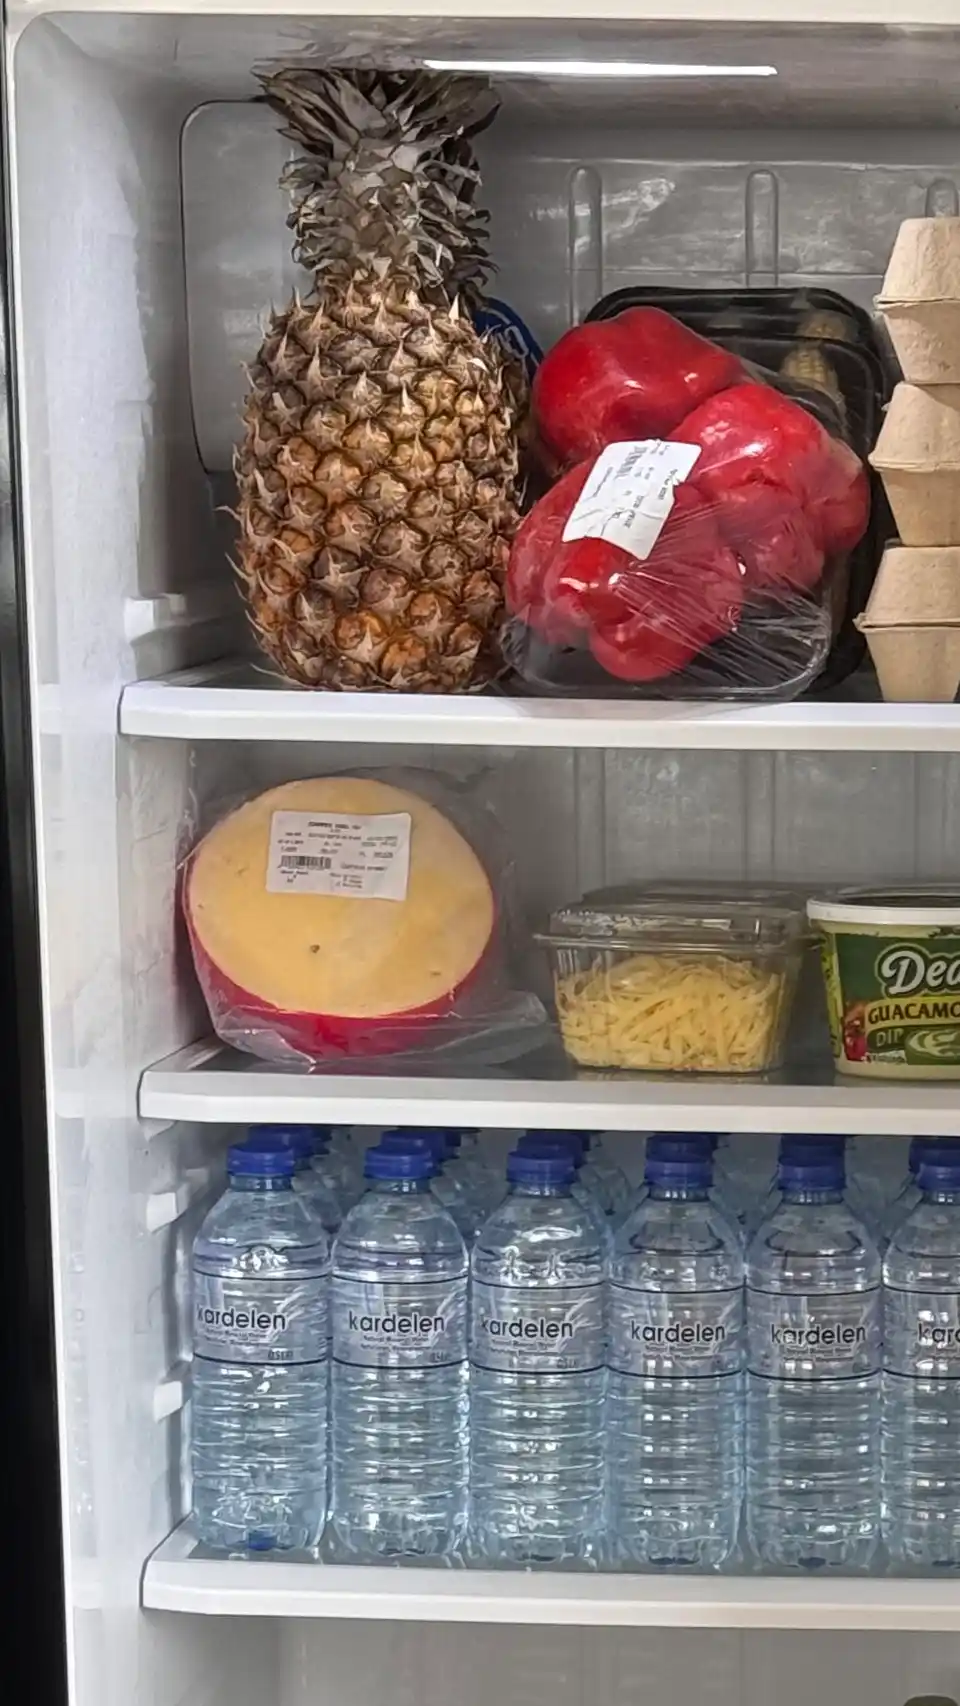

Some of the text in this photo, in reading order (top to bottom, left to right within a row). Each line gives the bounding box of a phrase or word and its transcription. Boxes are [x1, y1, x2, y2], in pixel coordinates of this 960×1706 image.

[349, 1310, 445, 1333] kardelen
[480, 1318, 573, 1338] kardelen
[631, 1320, 725, 1342] kardelen
[771, 1323, 866, 1345] kardelen
